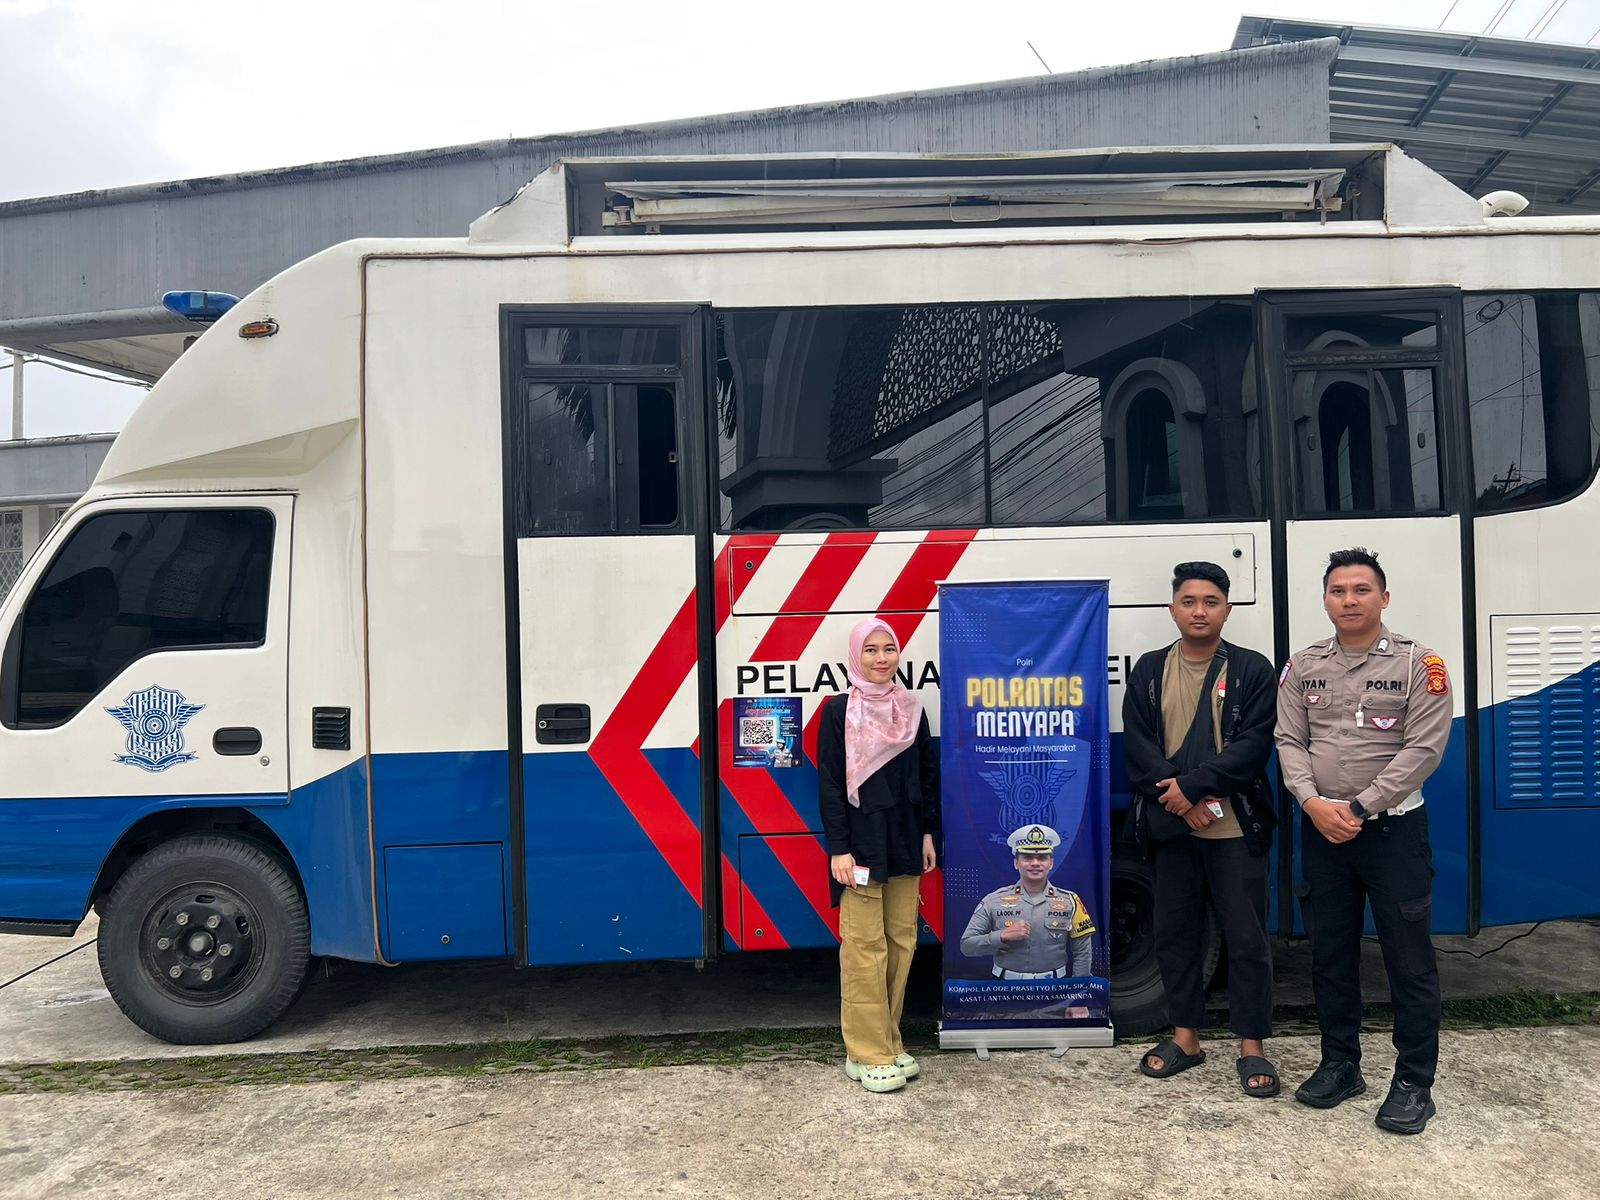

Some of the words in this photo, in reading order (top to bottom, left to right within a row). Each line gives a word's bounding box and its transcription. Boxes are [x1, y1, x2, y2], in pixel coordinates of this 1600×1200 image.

[1016, 658, 1033, 666] Polri
[737, 660, 940, 694] PELAYNA
[1366, 680, 1402, 691] POLRI
[966, 676, 1083, 707] POLANTAS
[976, 710, 1074, 737] MENYAPA
[975, 745, 995, 753] Hadir
[997, 745, 1031, 755] Melayani
[1032, 744, 1076, 755] Masyarakat
[959, 995, 981, 1003] KASAT
[1050, 992, 1093, 1001] SAMARINDA
